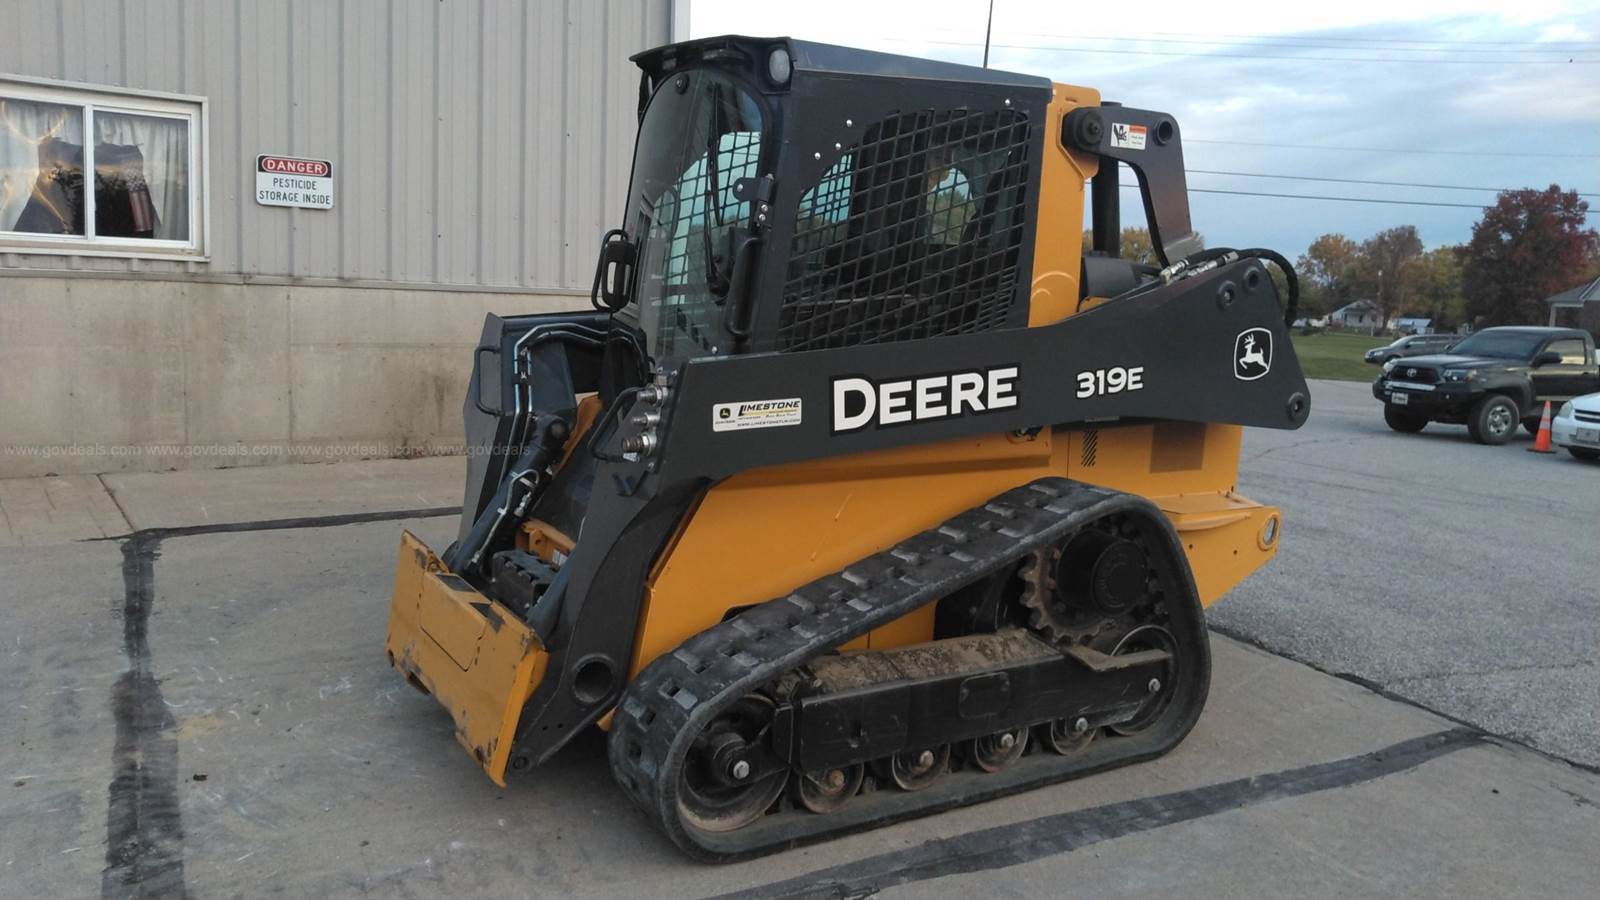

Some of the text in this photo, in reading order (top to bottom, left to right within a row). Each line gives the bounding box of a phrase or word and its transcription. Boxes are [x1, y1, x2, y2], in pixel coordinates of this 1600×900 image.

[266, 159, 323, 174] DANGER
[273, 177, 317, 190] PESTICIDE
[259, 190, 331, 205] STORAGE INSIDE
[1075, 365, 1145, 399] 319E
[833, 366, 1019, 432] DEERE
[738, 401, 800, 416] LIMESTONE
